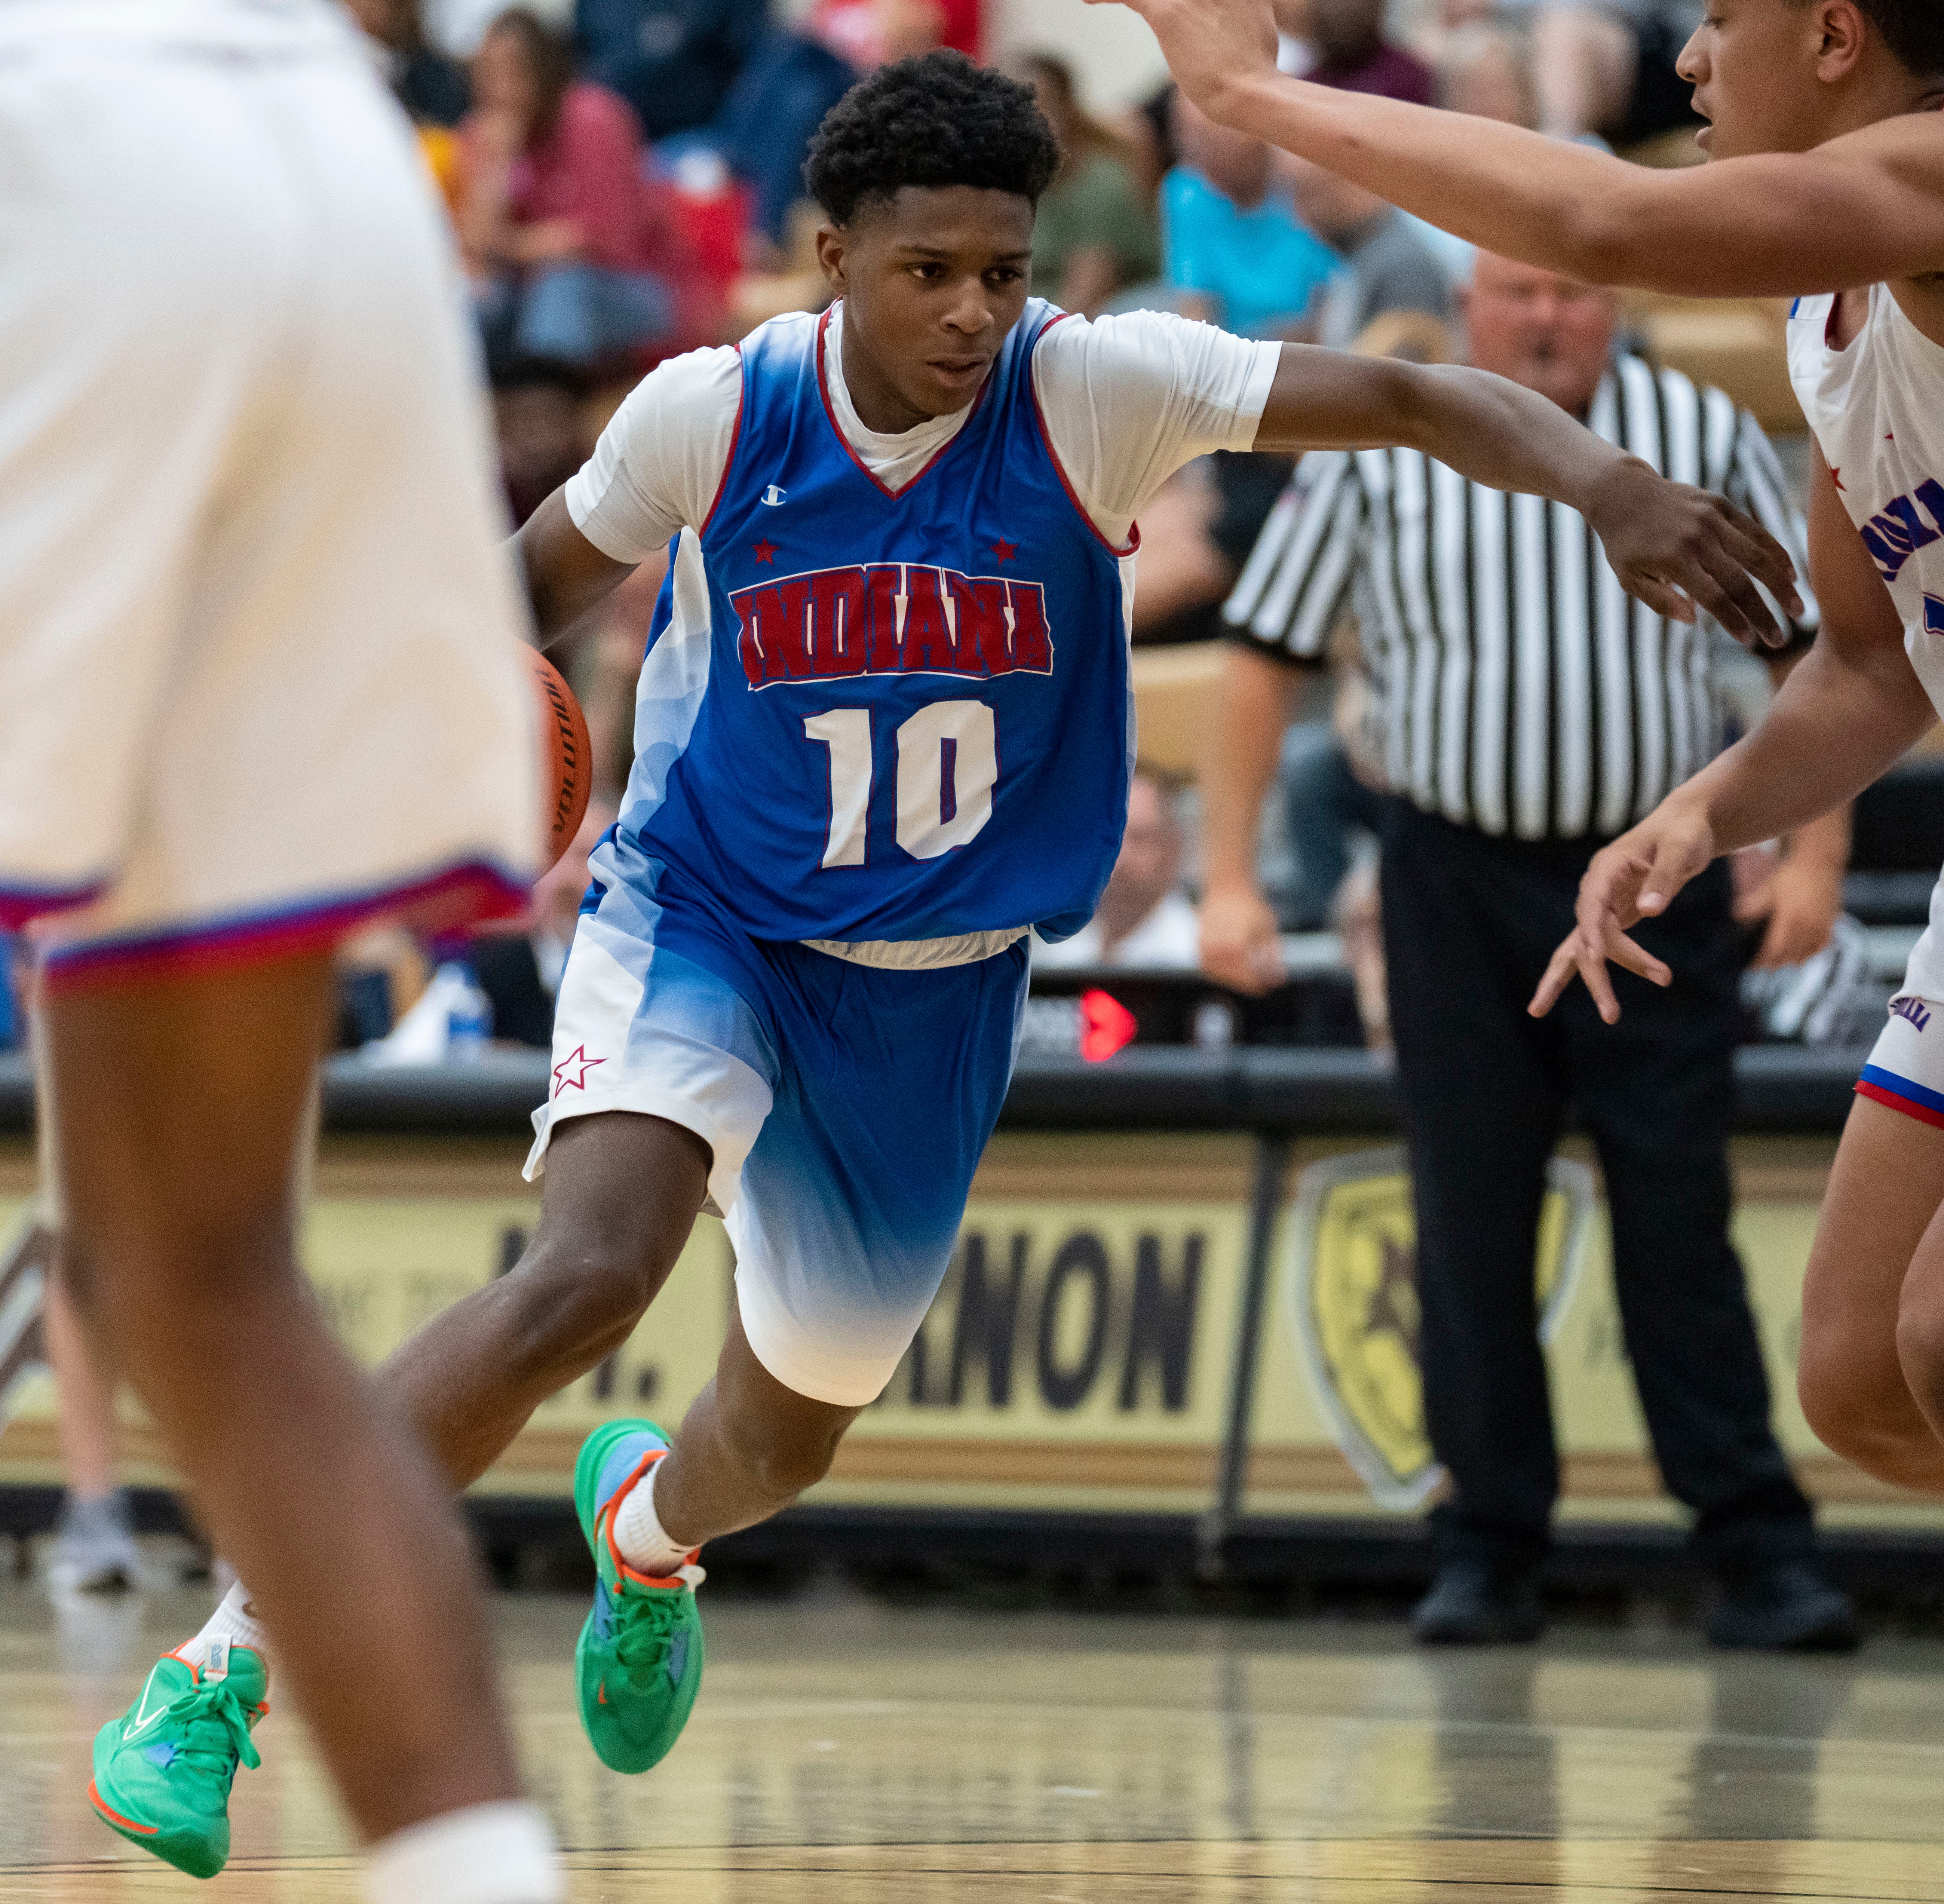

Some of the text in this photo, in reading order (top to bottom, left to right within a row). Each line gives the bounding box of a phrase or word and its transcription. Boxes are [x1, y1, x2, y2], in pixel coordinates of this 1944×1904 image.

[728, 562, 1054, 691] INDIANA
[536, 669, 577, 846] VOLUTION
[802, 696, 1001, 870] 10
